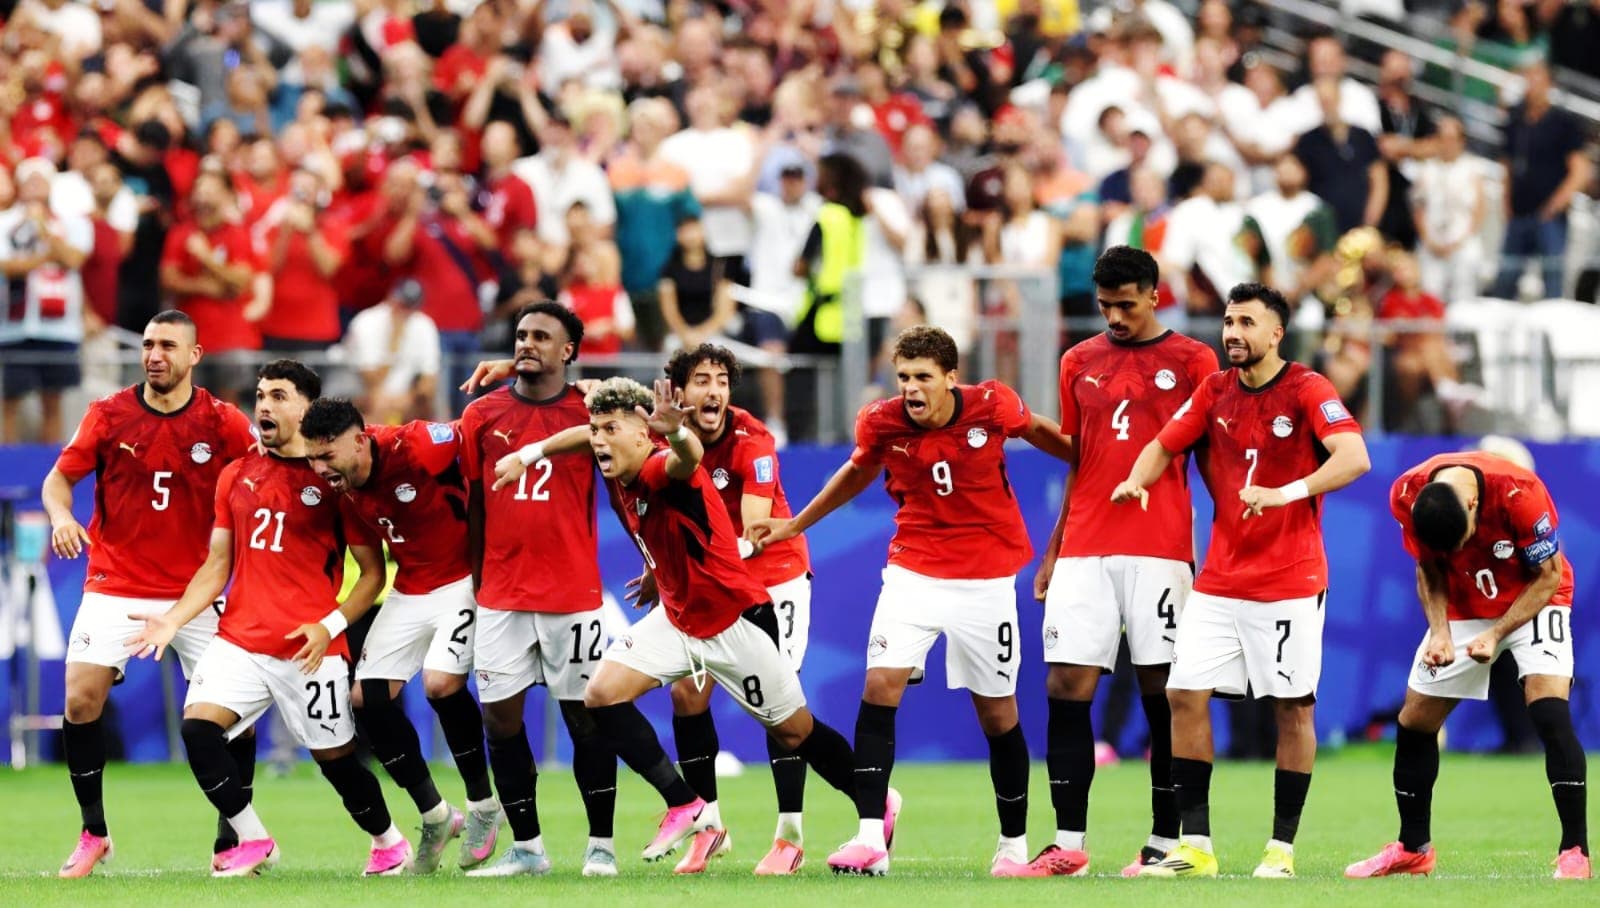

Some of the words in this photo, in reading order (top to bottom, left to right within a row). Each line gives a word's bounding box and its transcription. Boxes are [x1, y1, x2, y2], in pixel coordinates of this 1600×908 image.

[1111, 398, 1130, 441] 4
[514, 457, 552, 501] 12
[931, 460, 953, 497] 9
[1245, 448, 1258, 489] 7
[151, 470, 172, 511] 5
[250, 507, 285, 554] 21
[378, 517, 404, 543] 2
[450, 608, 475, 644] 2
[1157, 587, 1176, 629] 4
[1531, 609, 1564, 646] 10
[569, 619, 602, 664] 12
[998, 622, 1013, 662] 9
[1275, 620, 1291, 662] 7
[305, 680, 340, 720] 21
[743, 674, 764, 707] 8
